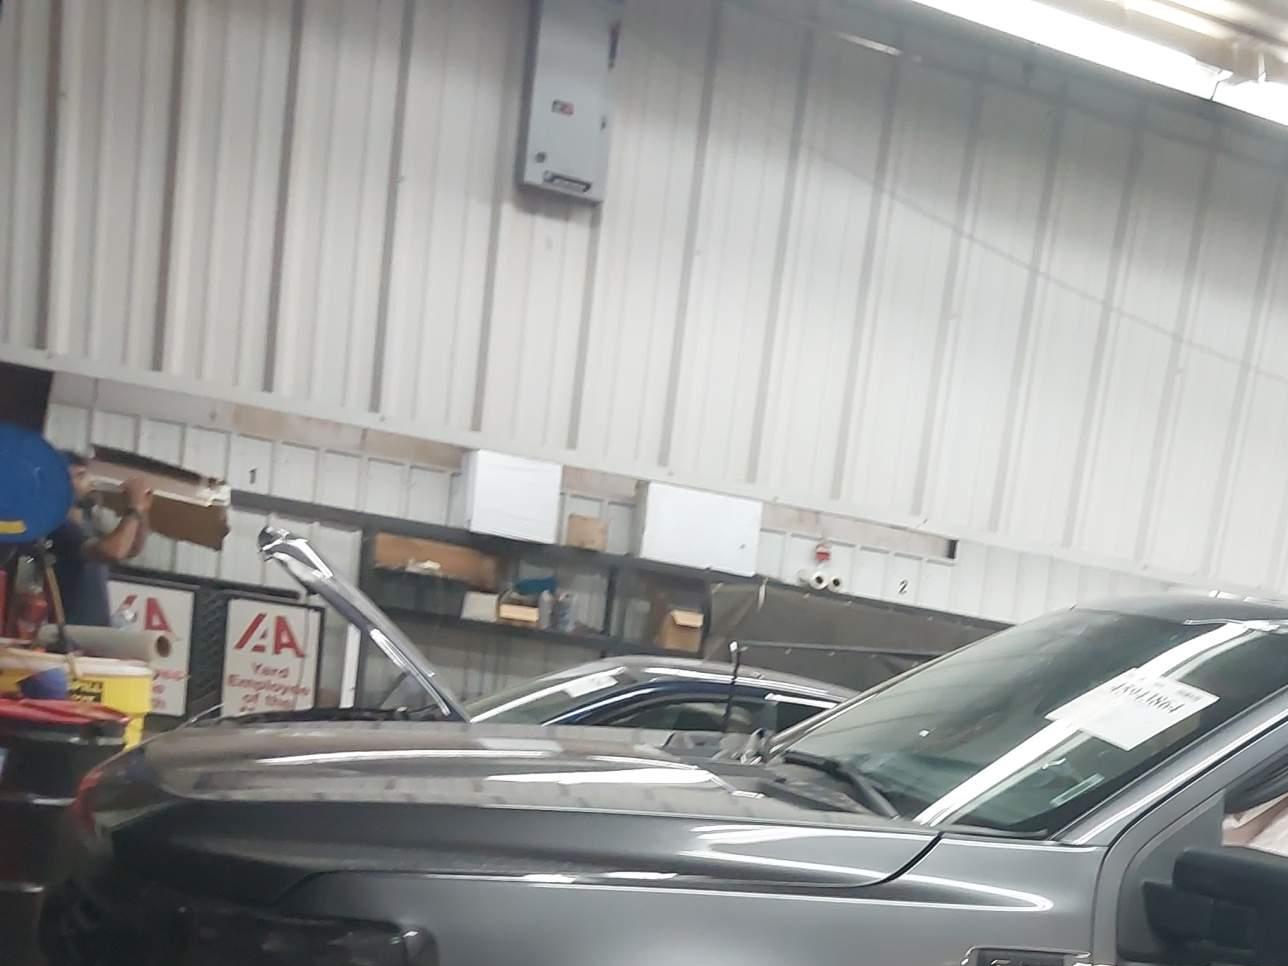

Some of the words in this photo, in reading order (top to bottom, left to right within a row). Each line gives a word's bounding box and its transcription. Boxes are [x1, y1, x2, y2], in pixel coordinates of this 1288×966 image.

[249, 468, 257, 484] 1
[899, 580, 908, 595] 2
[234, 612, 305, 658] IAA
[253, 663, 290, 680] Yard
